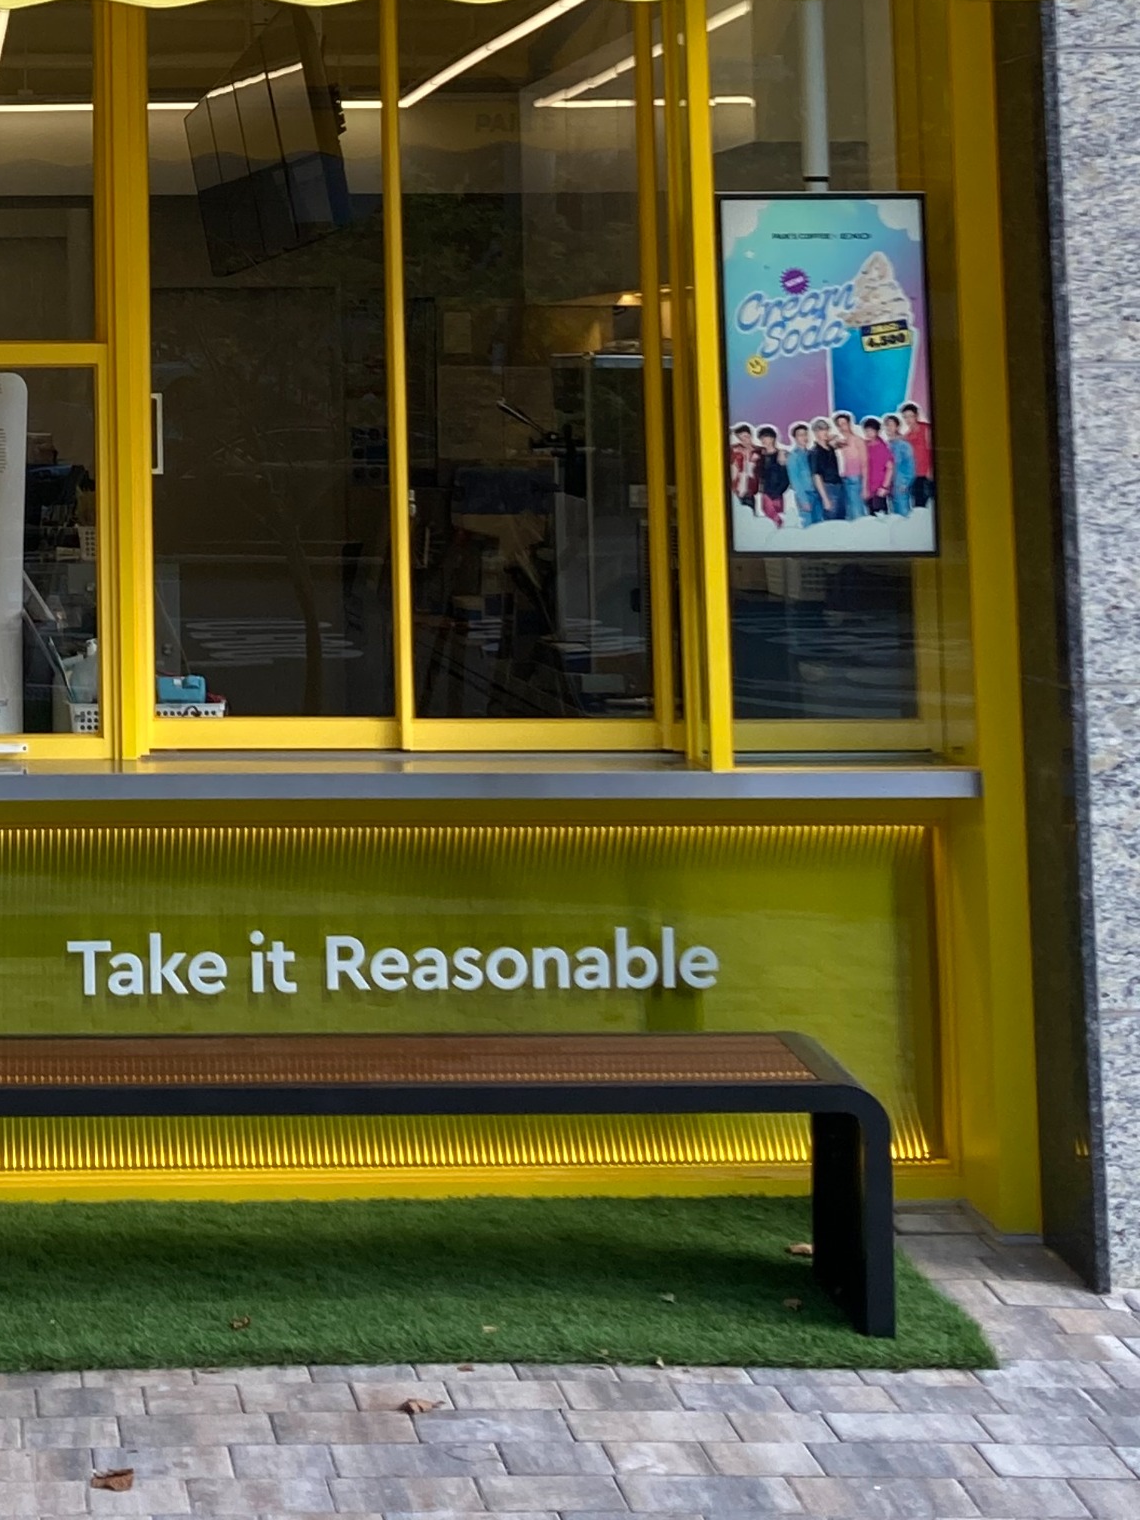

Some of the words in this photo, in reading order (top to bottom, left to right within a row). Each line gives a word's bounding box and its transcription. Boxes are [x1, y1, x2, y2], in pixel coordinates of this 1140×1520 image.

[736, 283, 856, 332] Cream
[759, 320, 847, 357] Soda
[67, 932, 228, 996] Take
[249, 930, 298, 993] it
[325, 926, 720, 991] Reasonable
